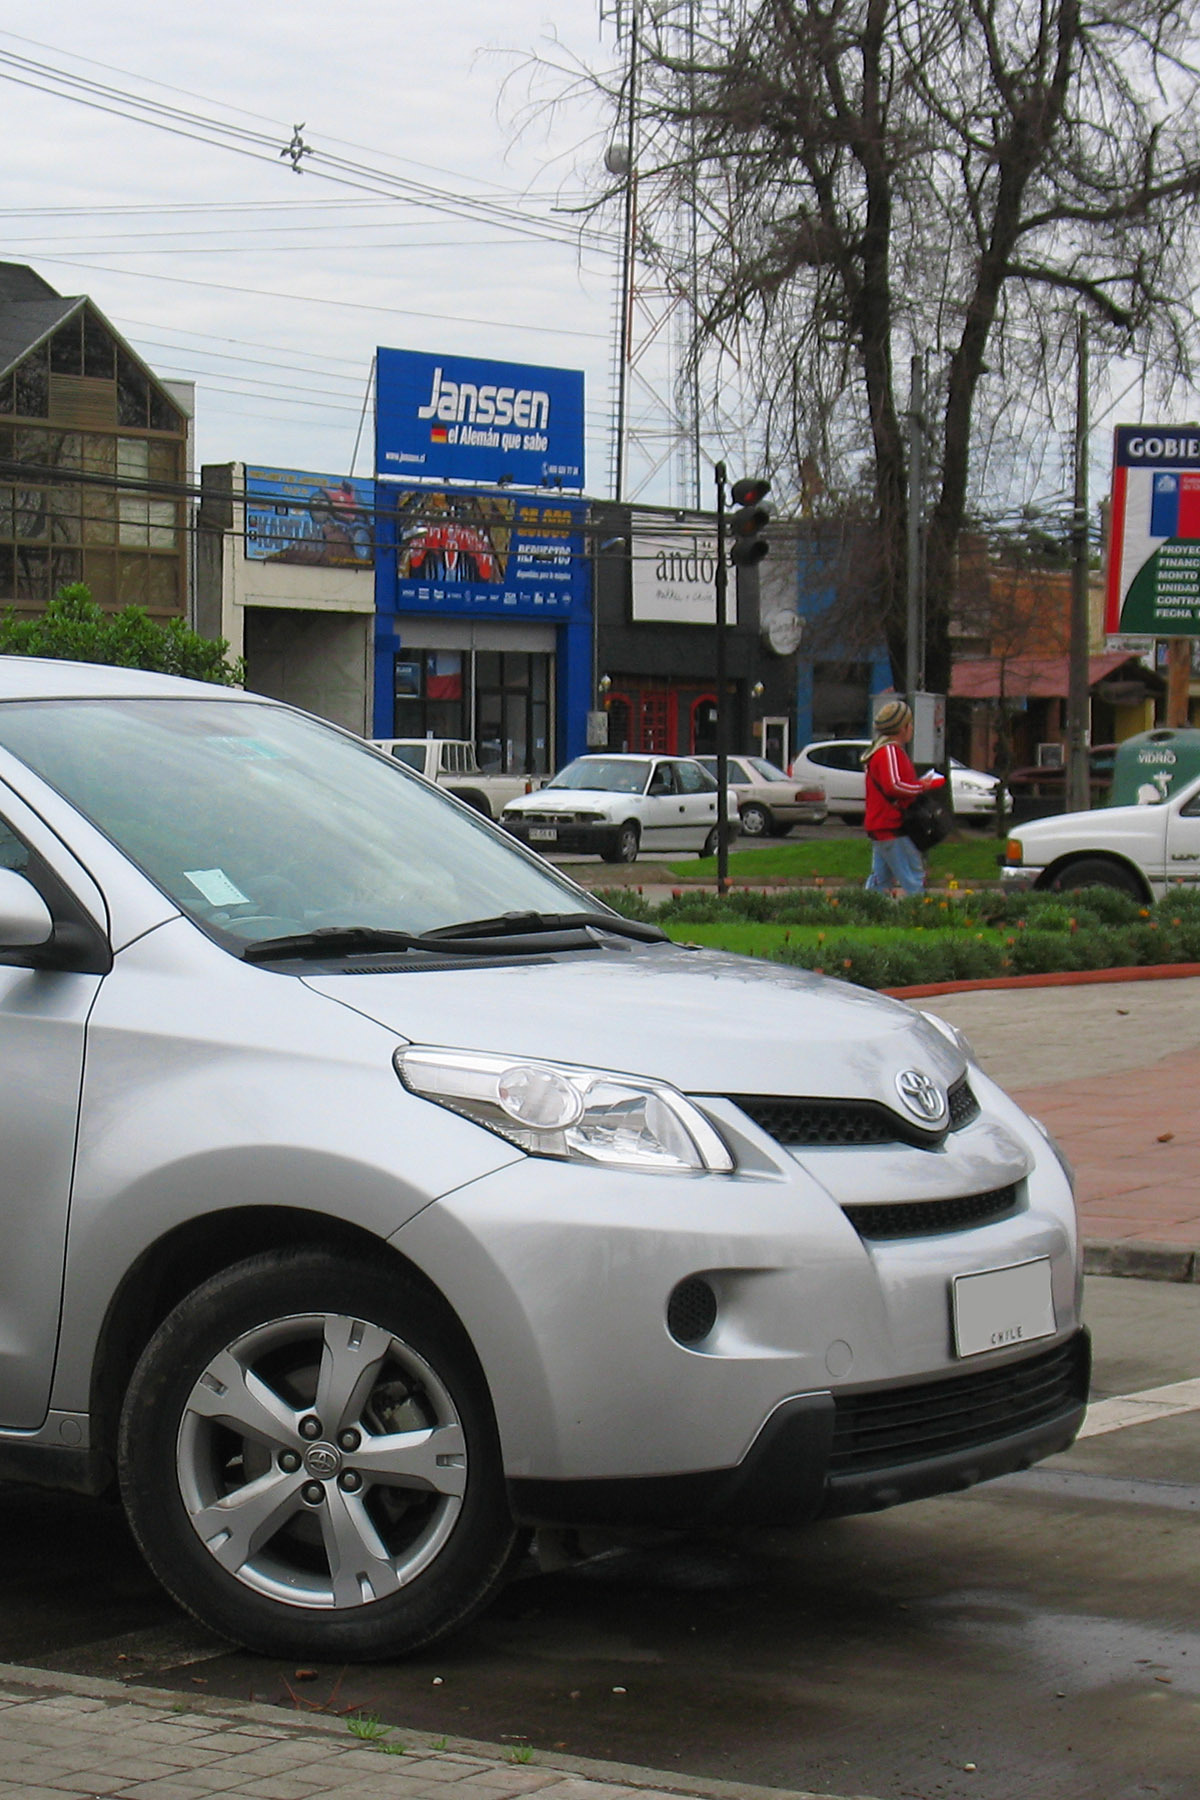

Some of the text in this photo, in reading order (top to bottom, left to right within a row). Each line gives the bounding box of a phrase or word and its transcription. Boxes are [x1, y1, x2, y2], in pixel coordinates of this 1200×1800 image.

[417, 367, 550, 430] Janssen
[448, 425, 549, 452] el Alemán que sabe
[1158, 570, 1198, 580] MONTO
[1157, 583, 1200, 593] UNIDAD
[1155, 607, 1192, 618] FECHA
[991, 1326, 1023, 1344] CHILE
